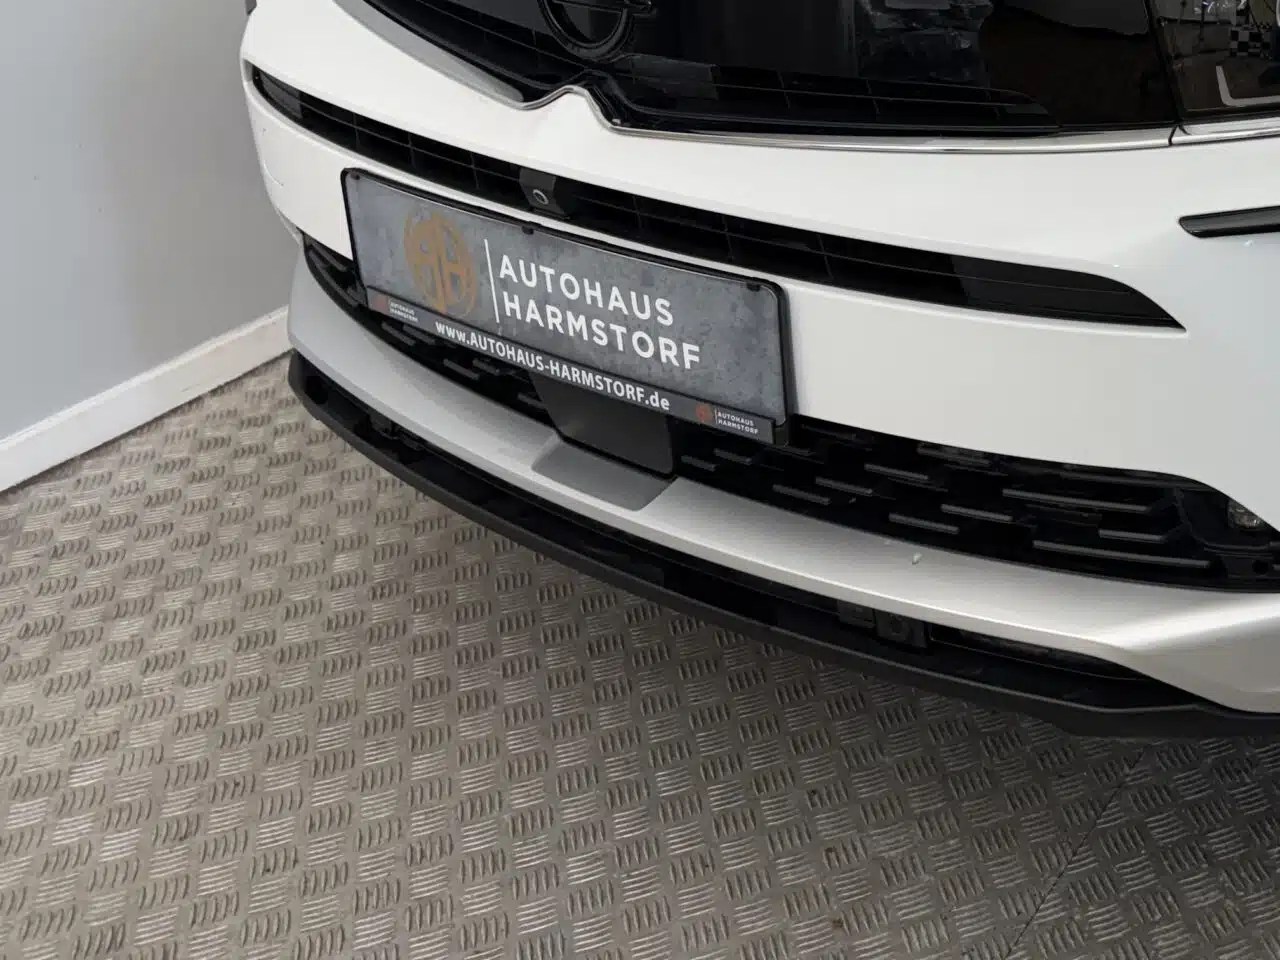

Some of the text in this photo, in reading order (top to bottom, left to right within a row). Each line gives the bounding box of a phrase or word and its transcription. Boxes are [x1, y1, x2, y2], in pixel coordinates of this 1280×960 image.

[499, 254, 674, 326] AUTOHAUS
[435, 321, 670, 411] www.AUTOHAUS-HARMSTORF.de
[502, 291, 700, 370] HARMSTORF
[717, 411, 754, 427] AUTOHAUS
[718, 419, 759, 435] HARMSTORF
